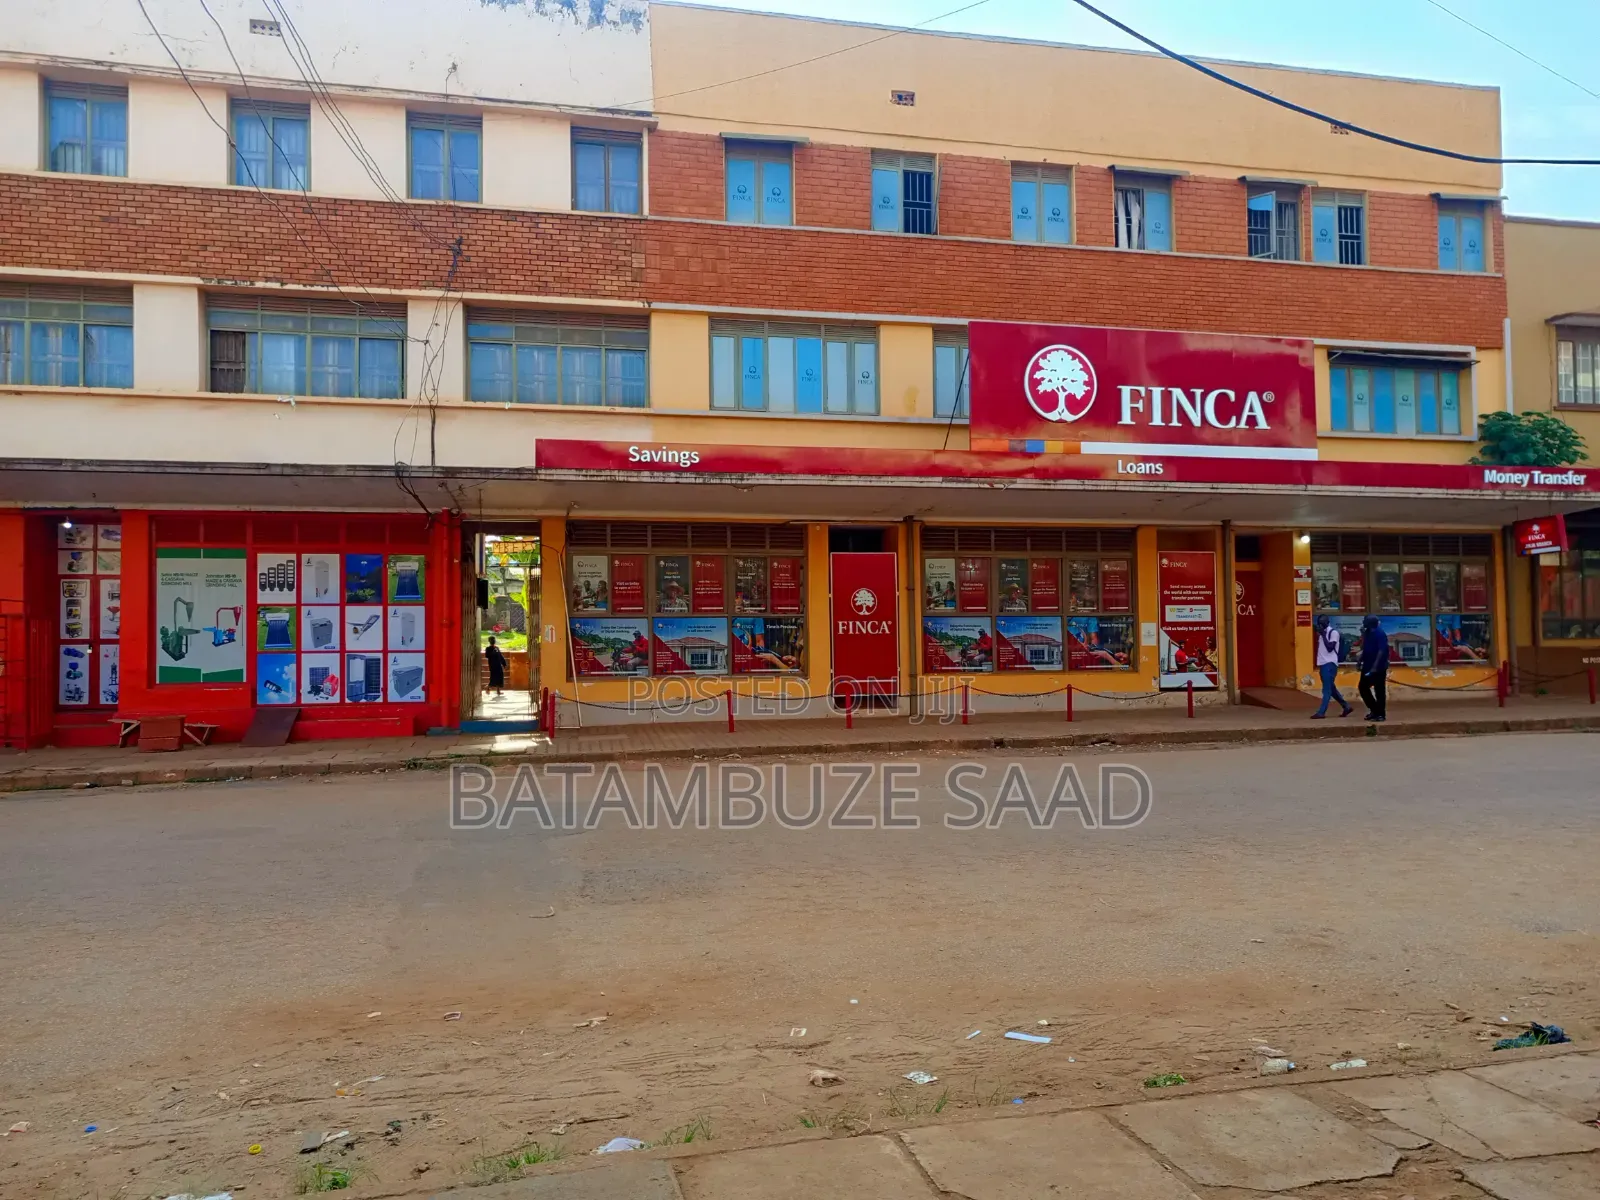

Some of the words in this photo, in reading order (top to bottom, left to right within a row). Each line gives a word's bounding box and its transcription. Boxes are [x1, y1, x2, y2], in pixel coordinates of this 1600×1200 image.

[628, 445, 700, 468] Savings
[1117, 459, 1164, 475] Loans
[1483, 469, 1530, 487] Money
[1531, 470, 1587, 486] Transfer
